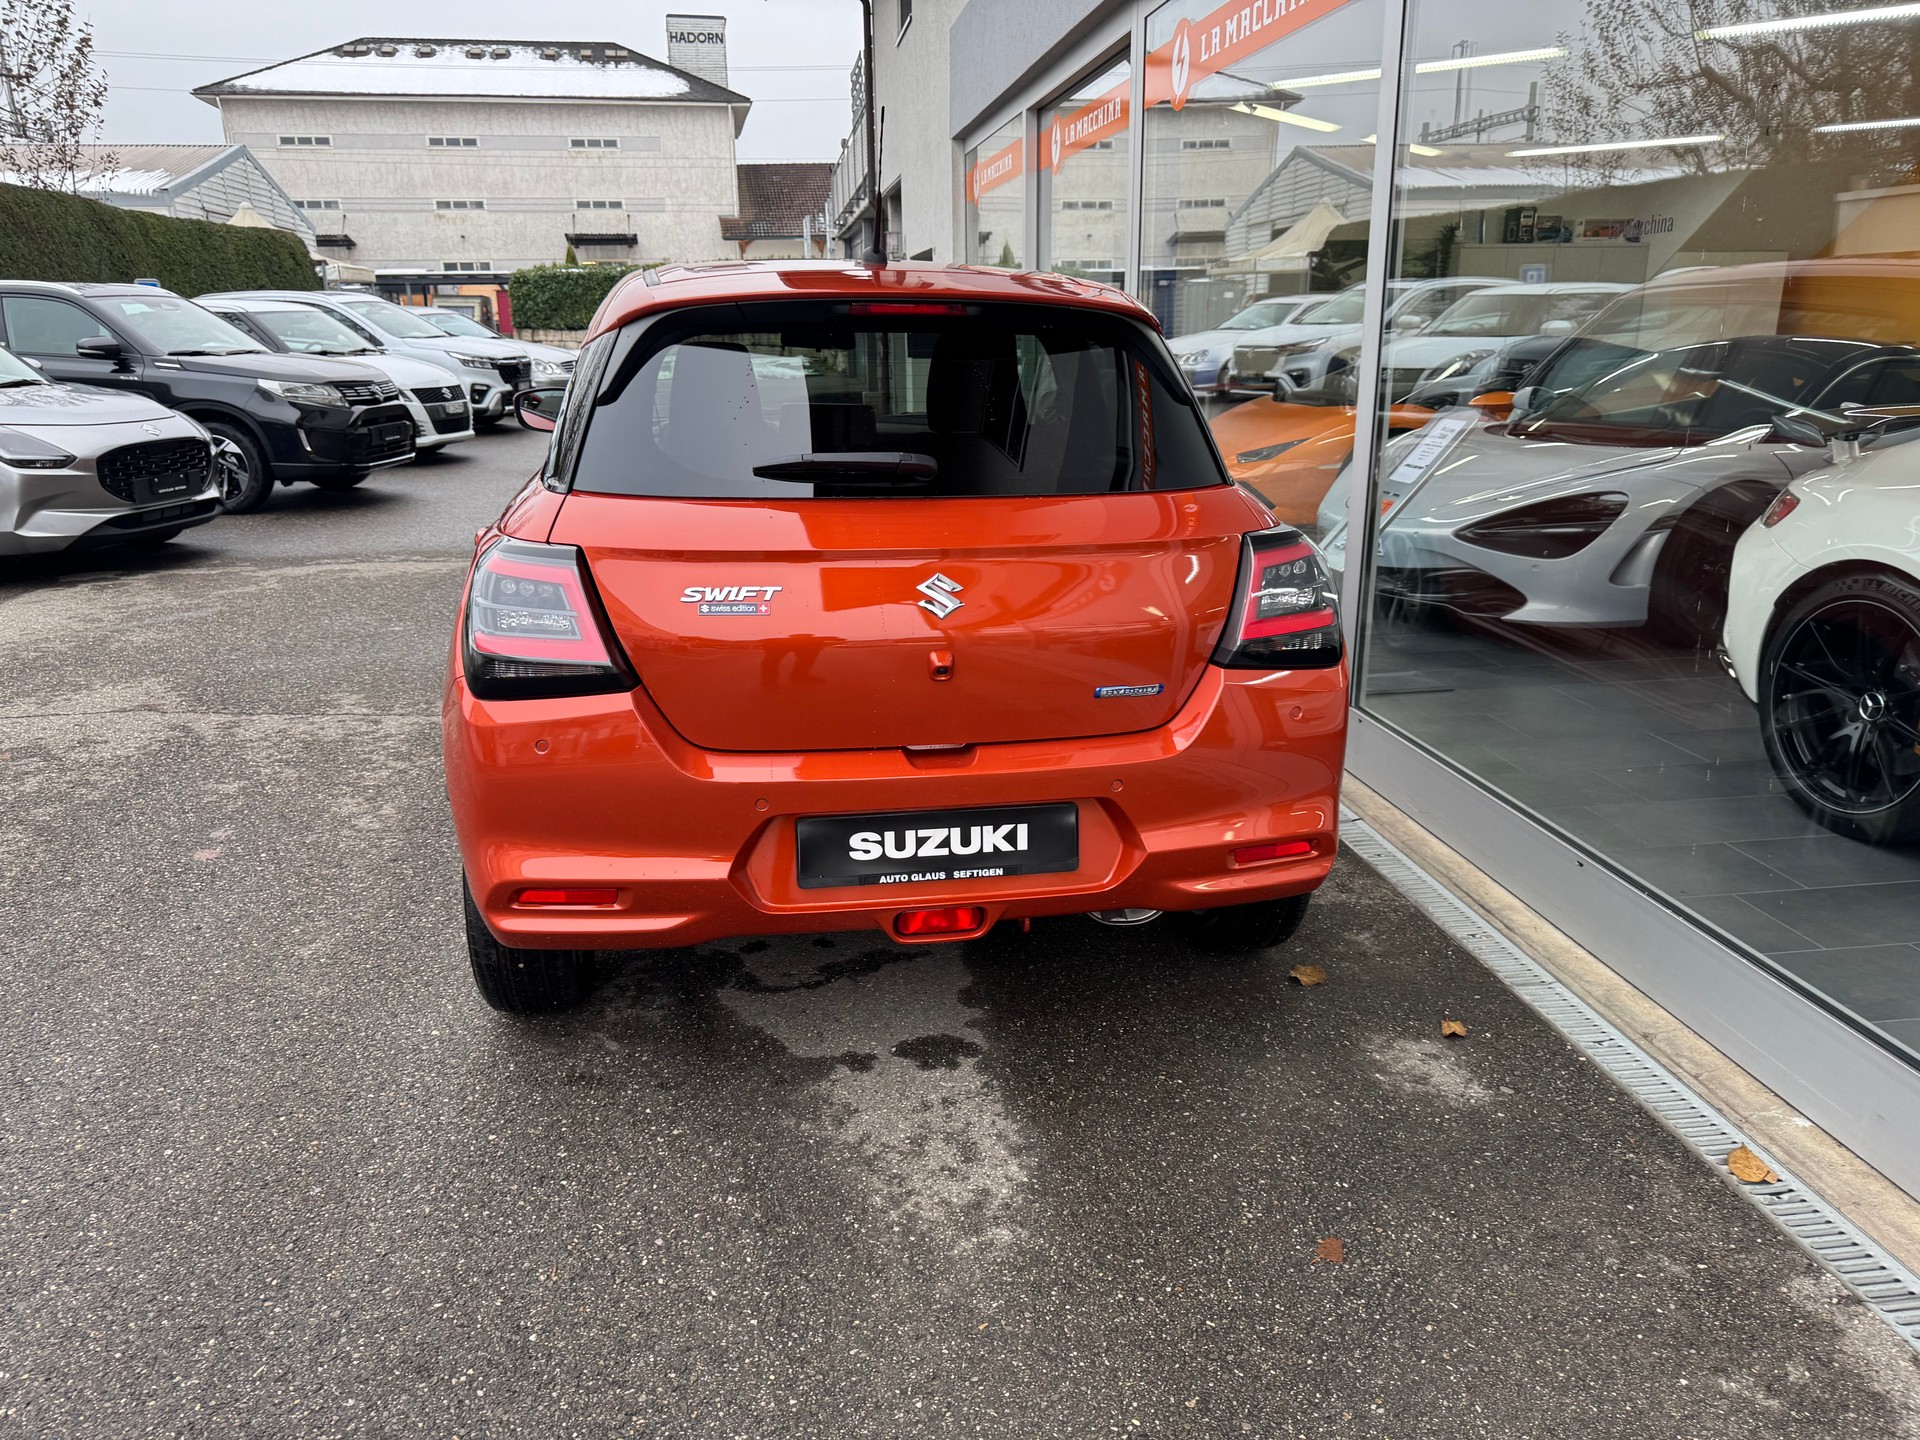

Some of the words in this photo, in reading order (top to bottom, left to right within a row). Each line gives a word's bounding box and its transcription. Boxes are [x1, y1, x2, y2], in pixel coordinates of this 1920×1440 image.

[669, 31, 724, 44] HADORN
[1200, 26, 1221, 63] LA
[1065, 123, 1075, 146] LA
[1076, 96, 1122, 140] MACCHINA
[680, 586, 783, 603] SWIFT
[1880, 582, 1920, 615] MICHE
[711, 604, 731, 612] swiss
[732, 604, 756, 612] edition
[848, 823, 1029, 861] SUZUKI
[879, 874, 909, 884] AUTO
[911, 871, 946, 882] GLAUS
[953, 867, 1004, 879] SEFTIGEN
